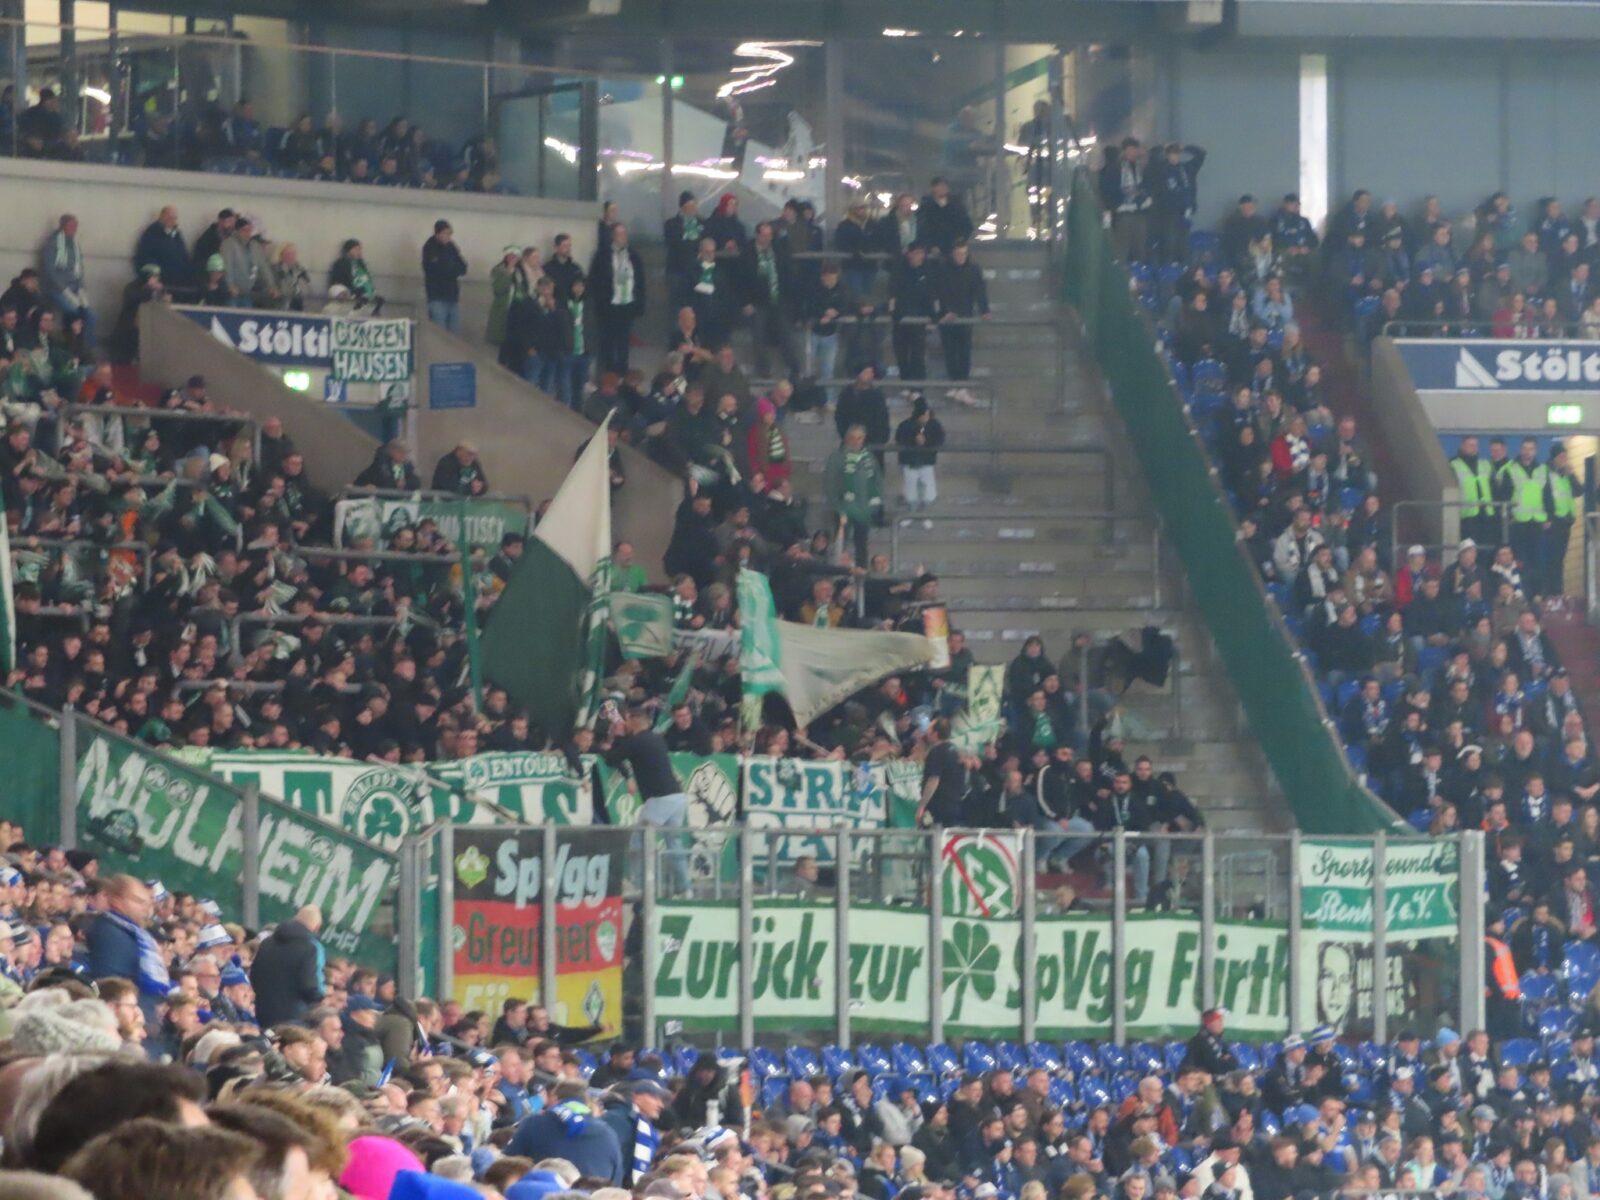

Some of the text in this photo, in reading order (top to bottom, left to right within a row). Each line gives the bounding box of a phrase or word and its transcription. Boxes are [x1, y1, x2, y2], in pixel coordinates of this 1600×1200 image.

[238, 320, 331, 357] Stölti
[334, 352, 408, 380] HAUSEN
[655, 912, 926, 1003] Zurück zur
[1006, 930, 1290, 1024] SpVgg Fürth
